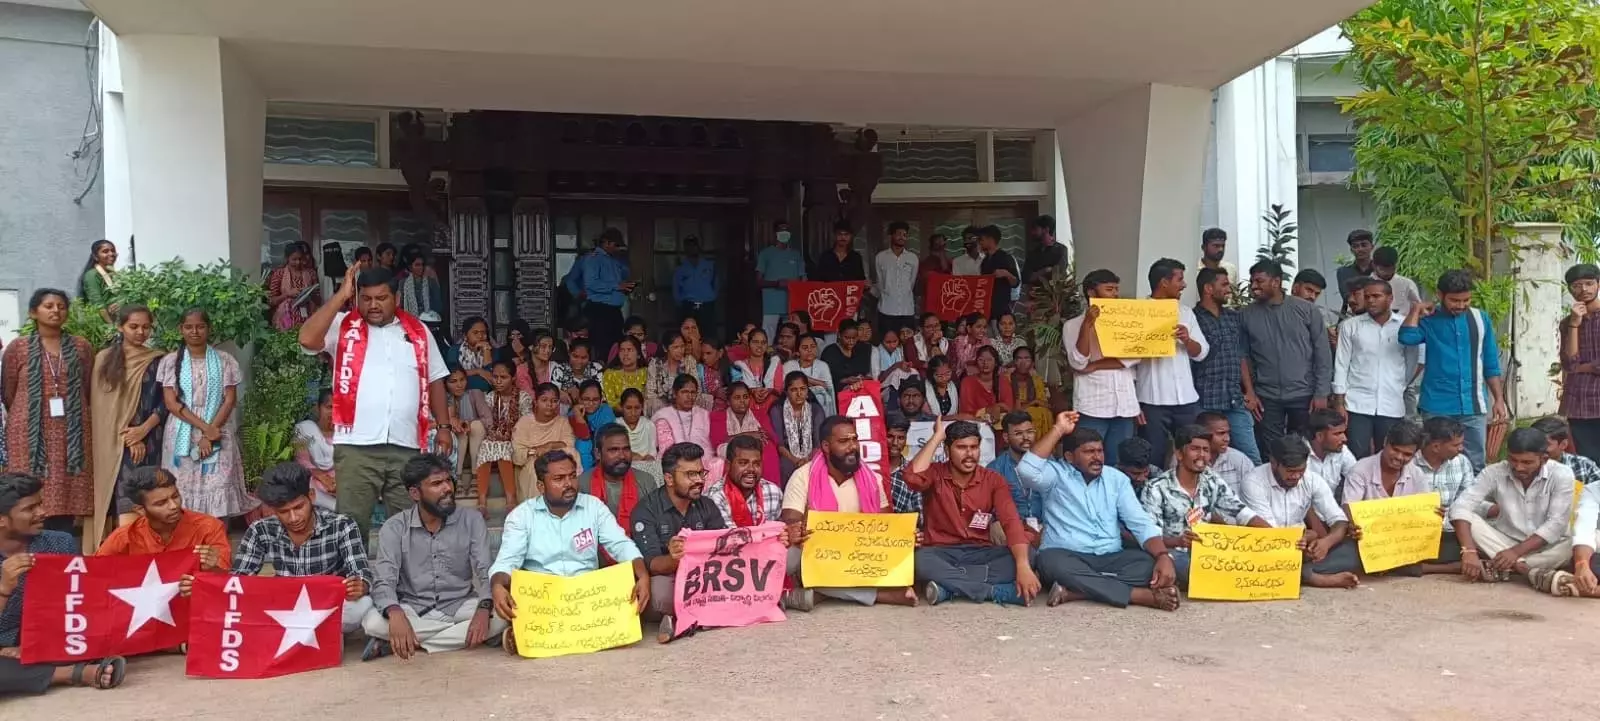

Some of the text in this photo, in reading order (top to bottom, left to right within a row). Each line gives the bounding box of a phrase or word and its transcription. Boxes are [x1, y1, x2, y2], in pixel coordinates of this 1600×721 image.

[339, 328, 361, 395] AIFDS
[573, 530, 593, 548] DSA
[64, 556, 88, 656] AIFDS
[682, 558, 777, 602] BRSV
[219, 576, 244, 672] AIFDS
